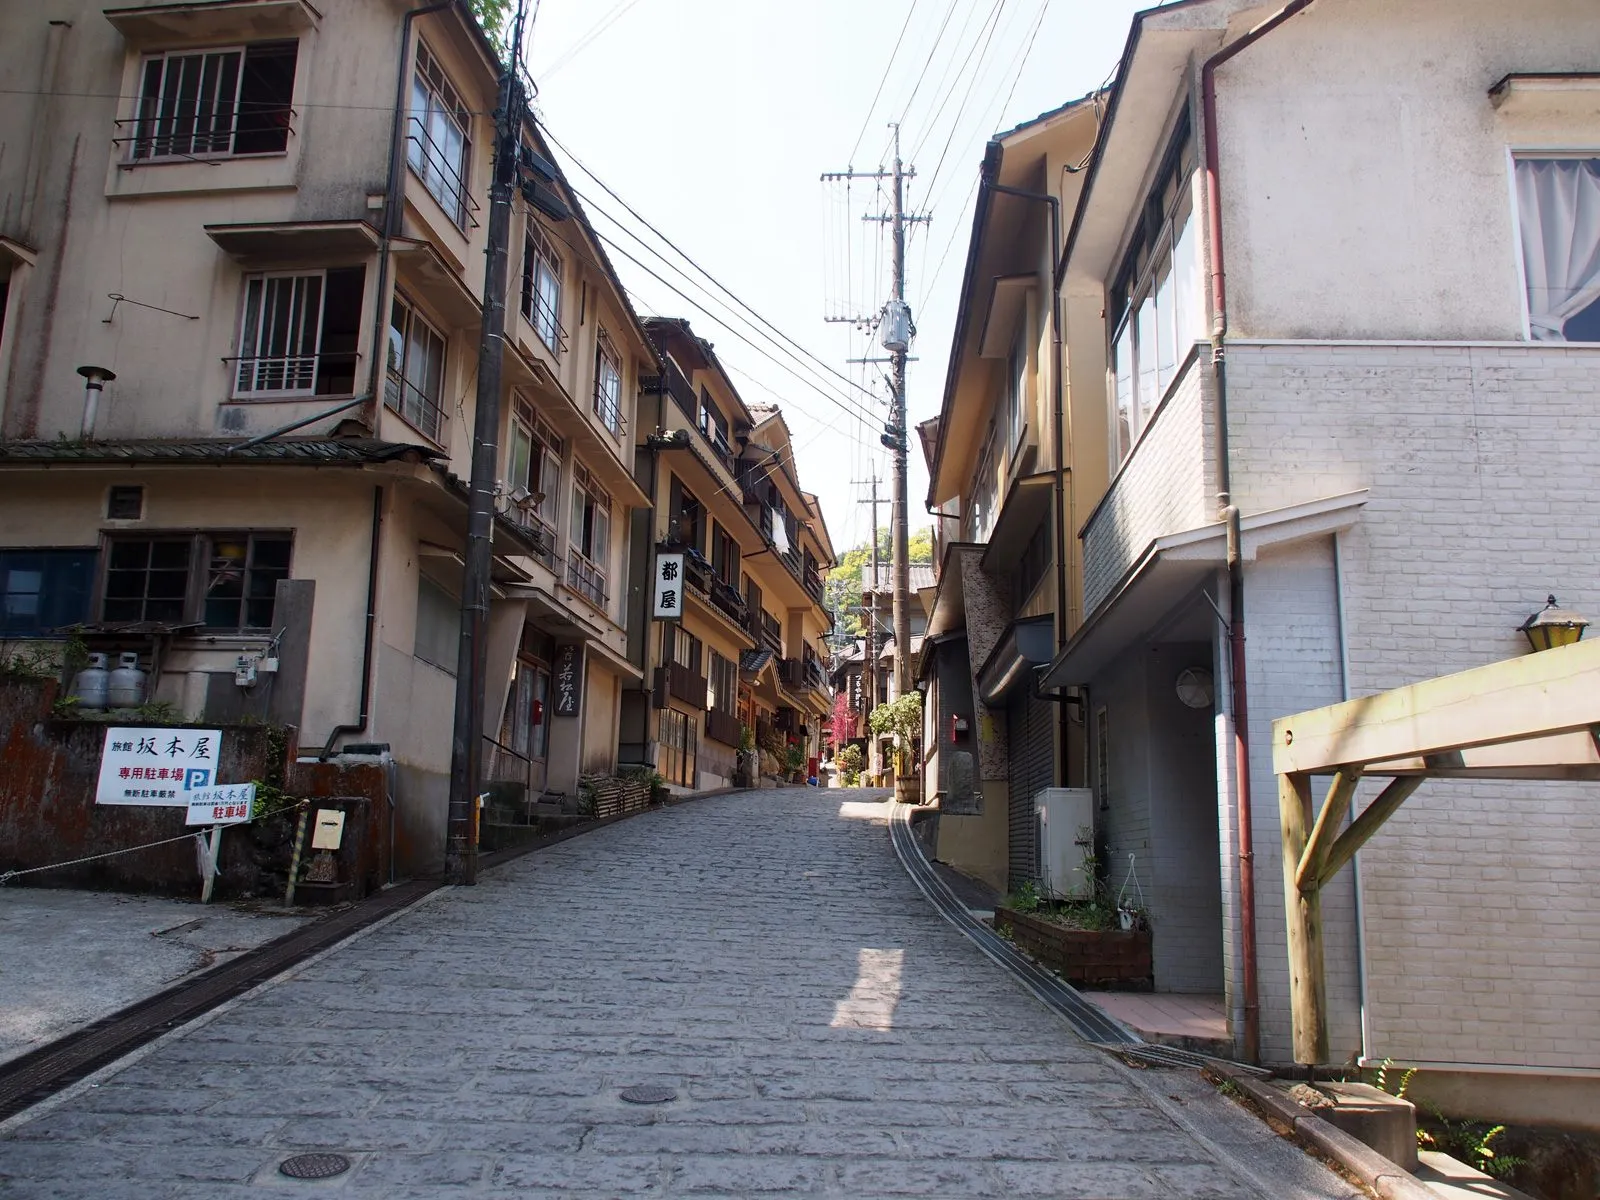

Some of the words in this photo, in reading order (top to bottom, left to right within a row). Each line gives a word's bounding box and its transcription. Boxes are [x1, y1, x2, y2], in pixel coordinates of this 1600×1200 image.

[660, 561, 678, 609] 都屋
[111, 741, 134, 752] 旅館
[136, 736, 211, 759] 坂本屋
[118, 766, 185, 781] 専用駐車場
[212, 805, 247, 819] 駐車場
